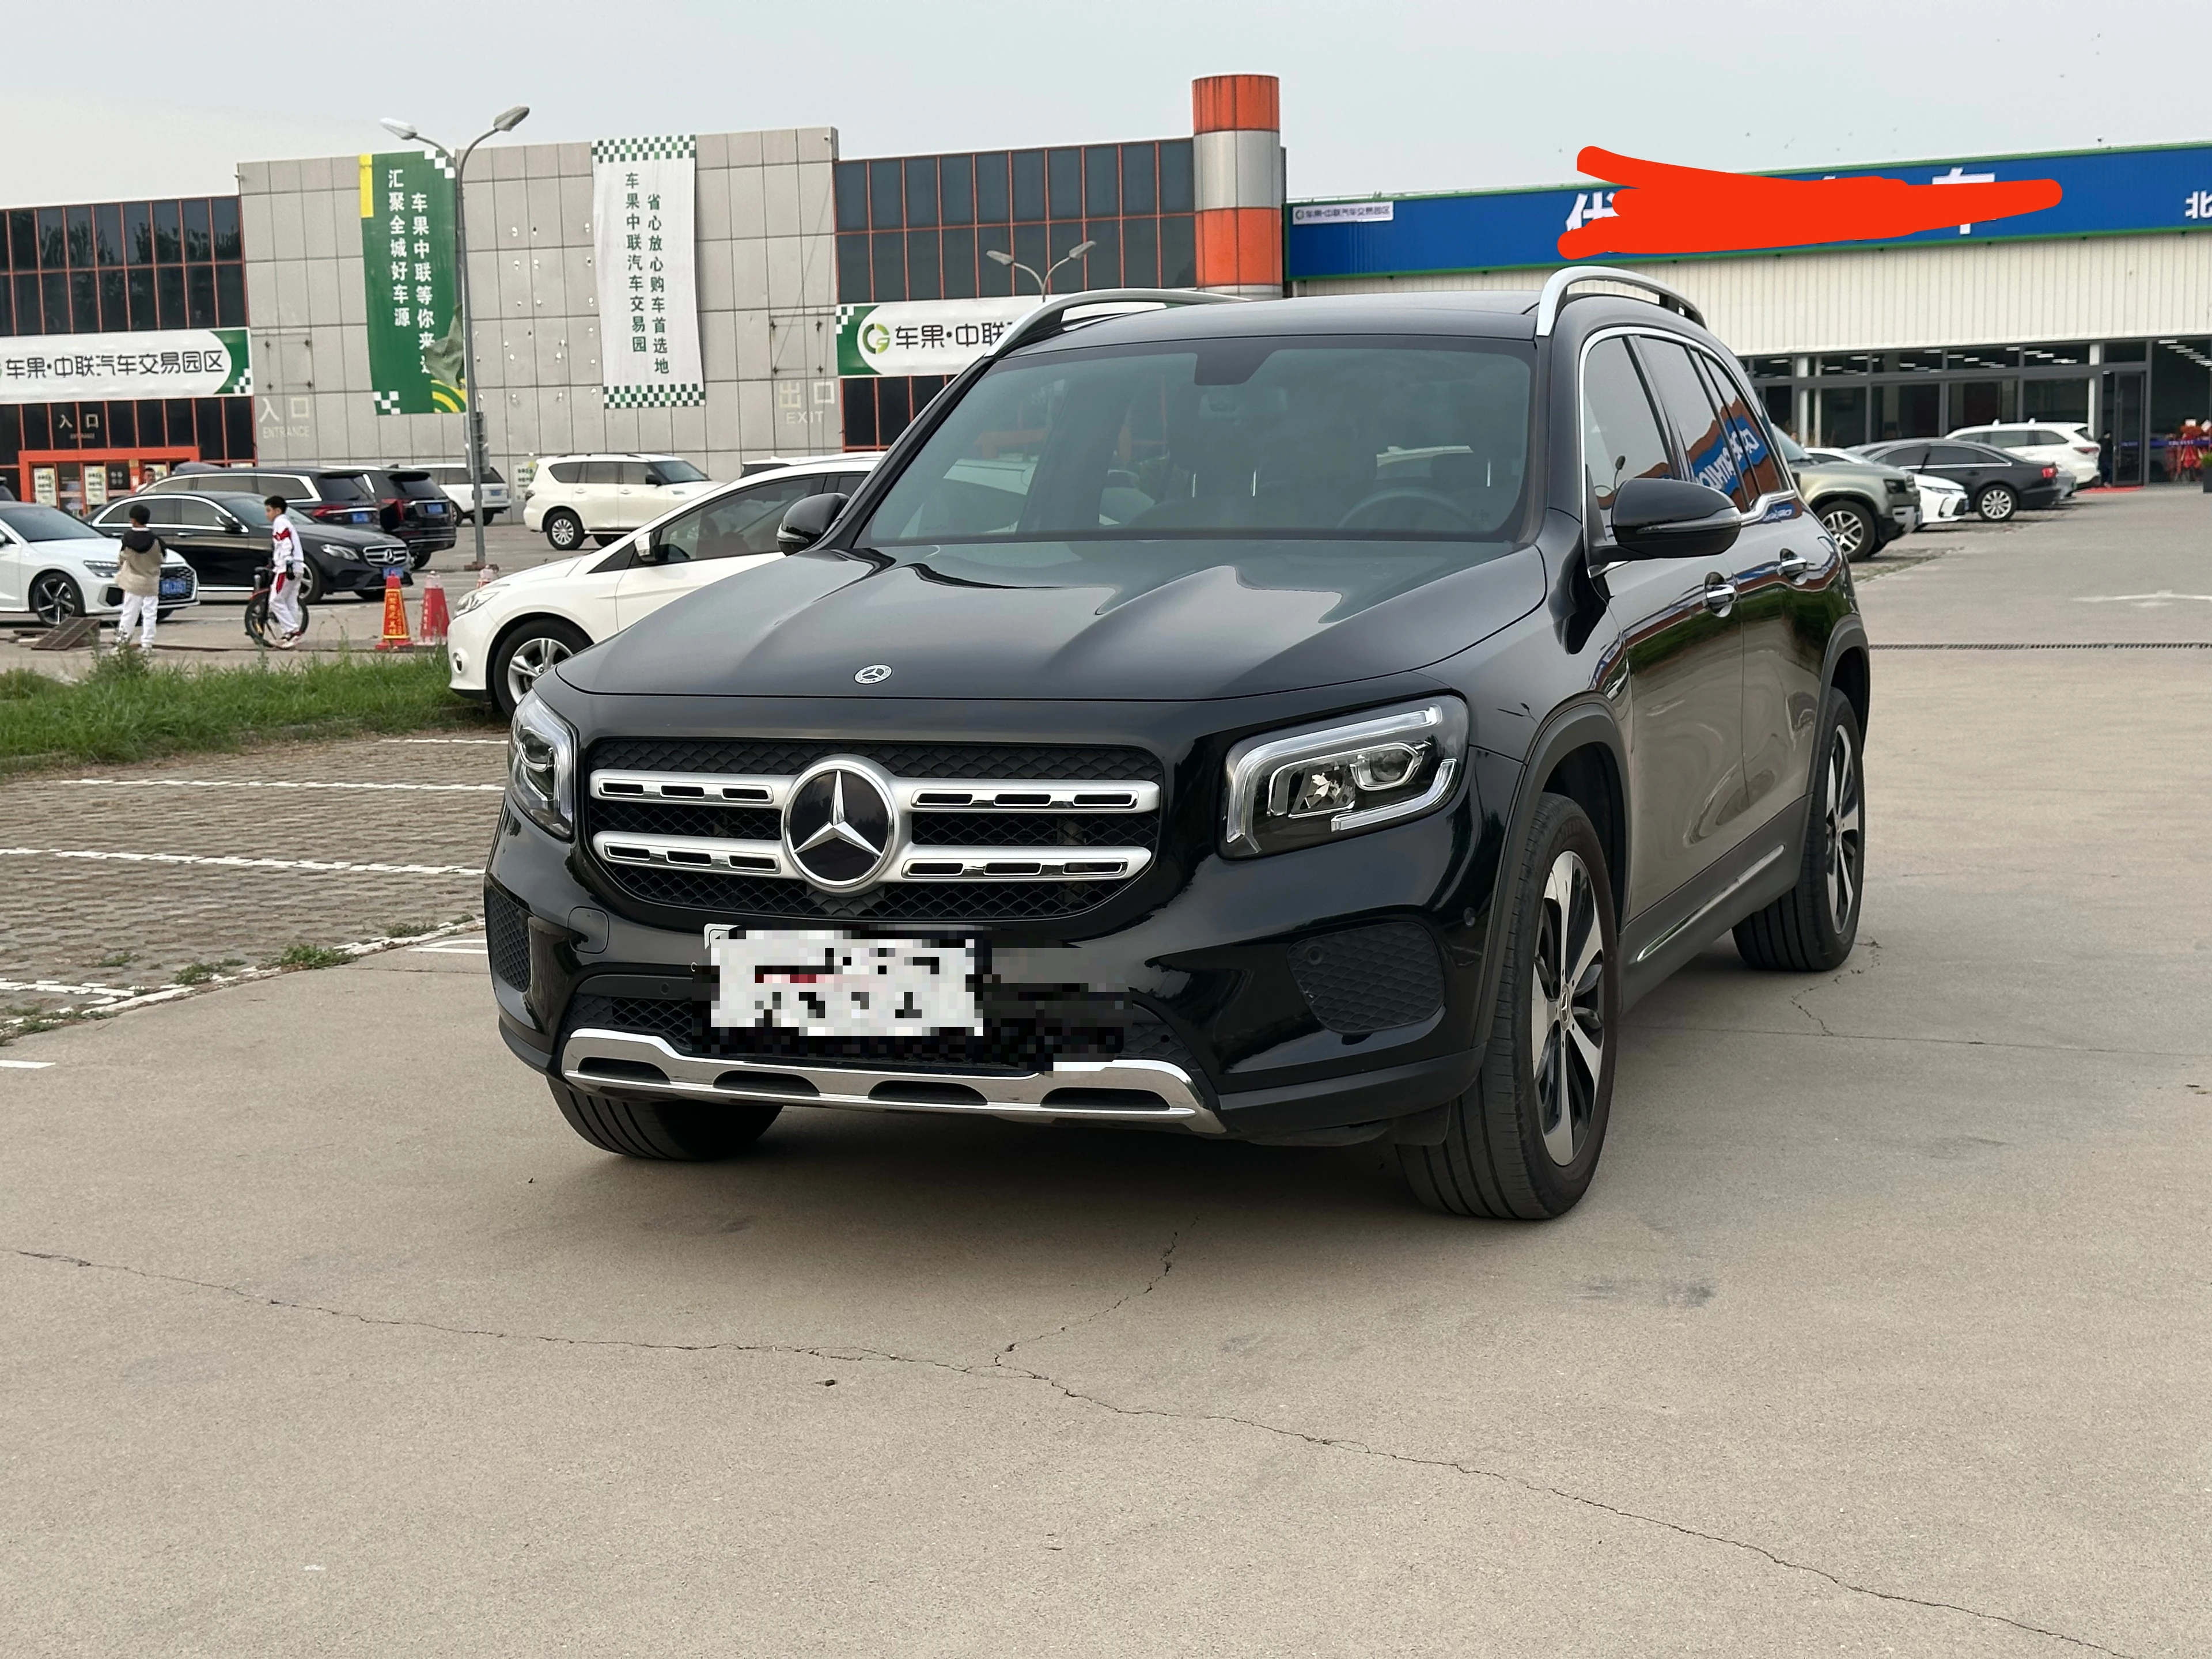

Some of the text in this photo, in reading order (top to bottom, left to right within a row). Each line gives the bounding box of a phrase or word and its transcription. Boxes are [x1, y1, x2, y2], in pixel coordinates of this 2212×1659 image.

[388, 169, 411, 327] 汇聚全城好车源
[625, 172, 647, 353] 车果中联汽车交易园
[411, 192, 435, 374] 车果中联等你来
[647, 193, 669, 374] 省心放心购车首选地
[895, 321, 1013, 350] 车果·中联
[6, 350, 225, 379] 车果·中联汽车交易园区
[779, 380, 835, 409] 出口
[59, 413, 99, 429] 入口
[259, 396, 309, 423] 入口
[786, 410, 824, 424] EXIT
